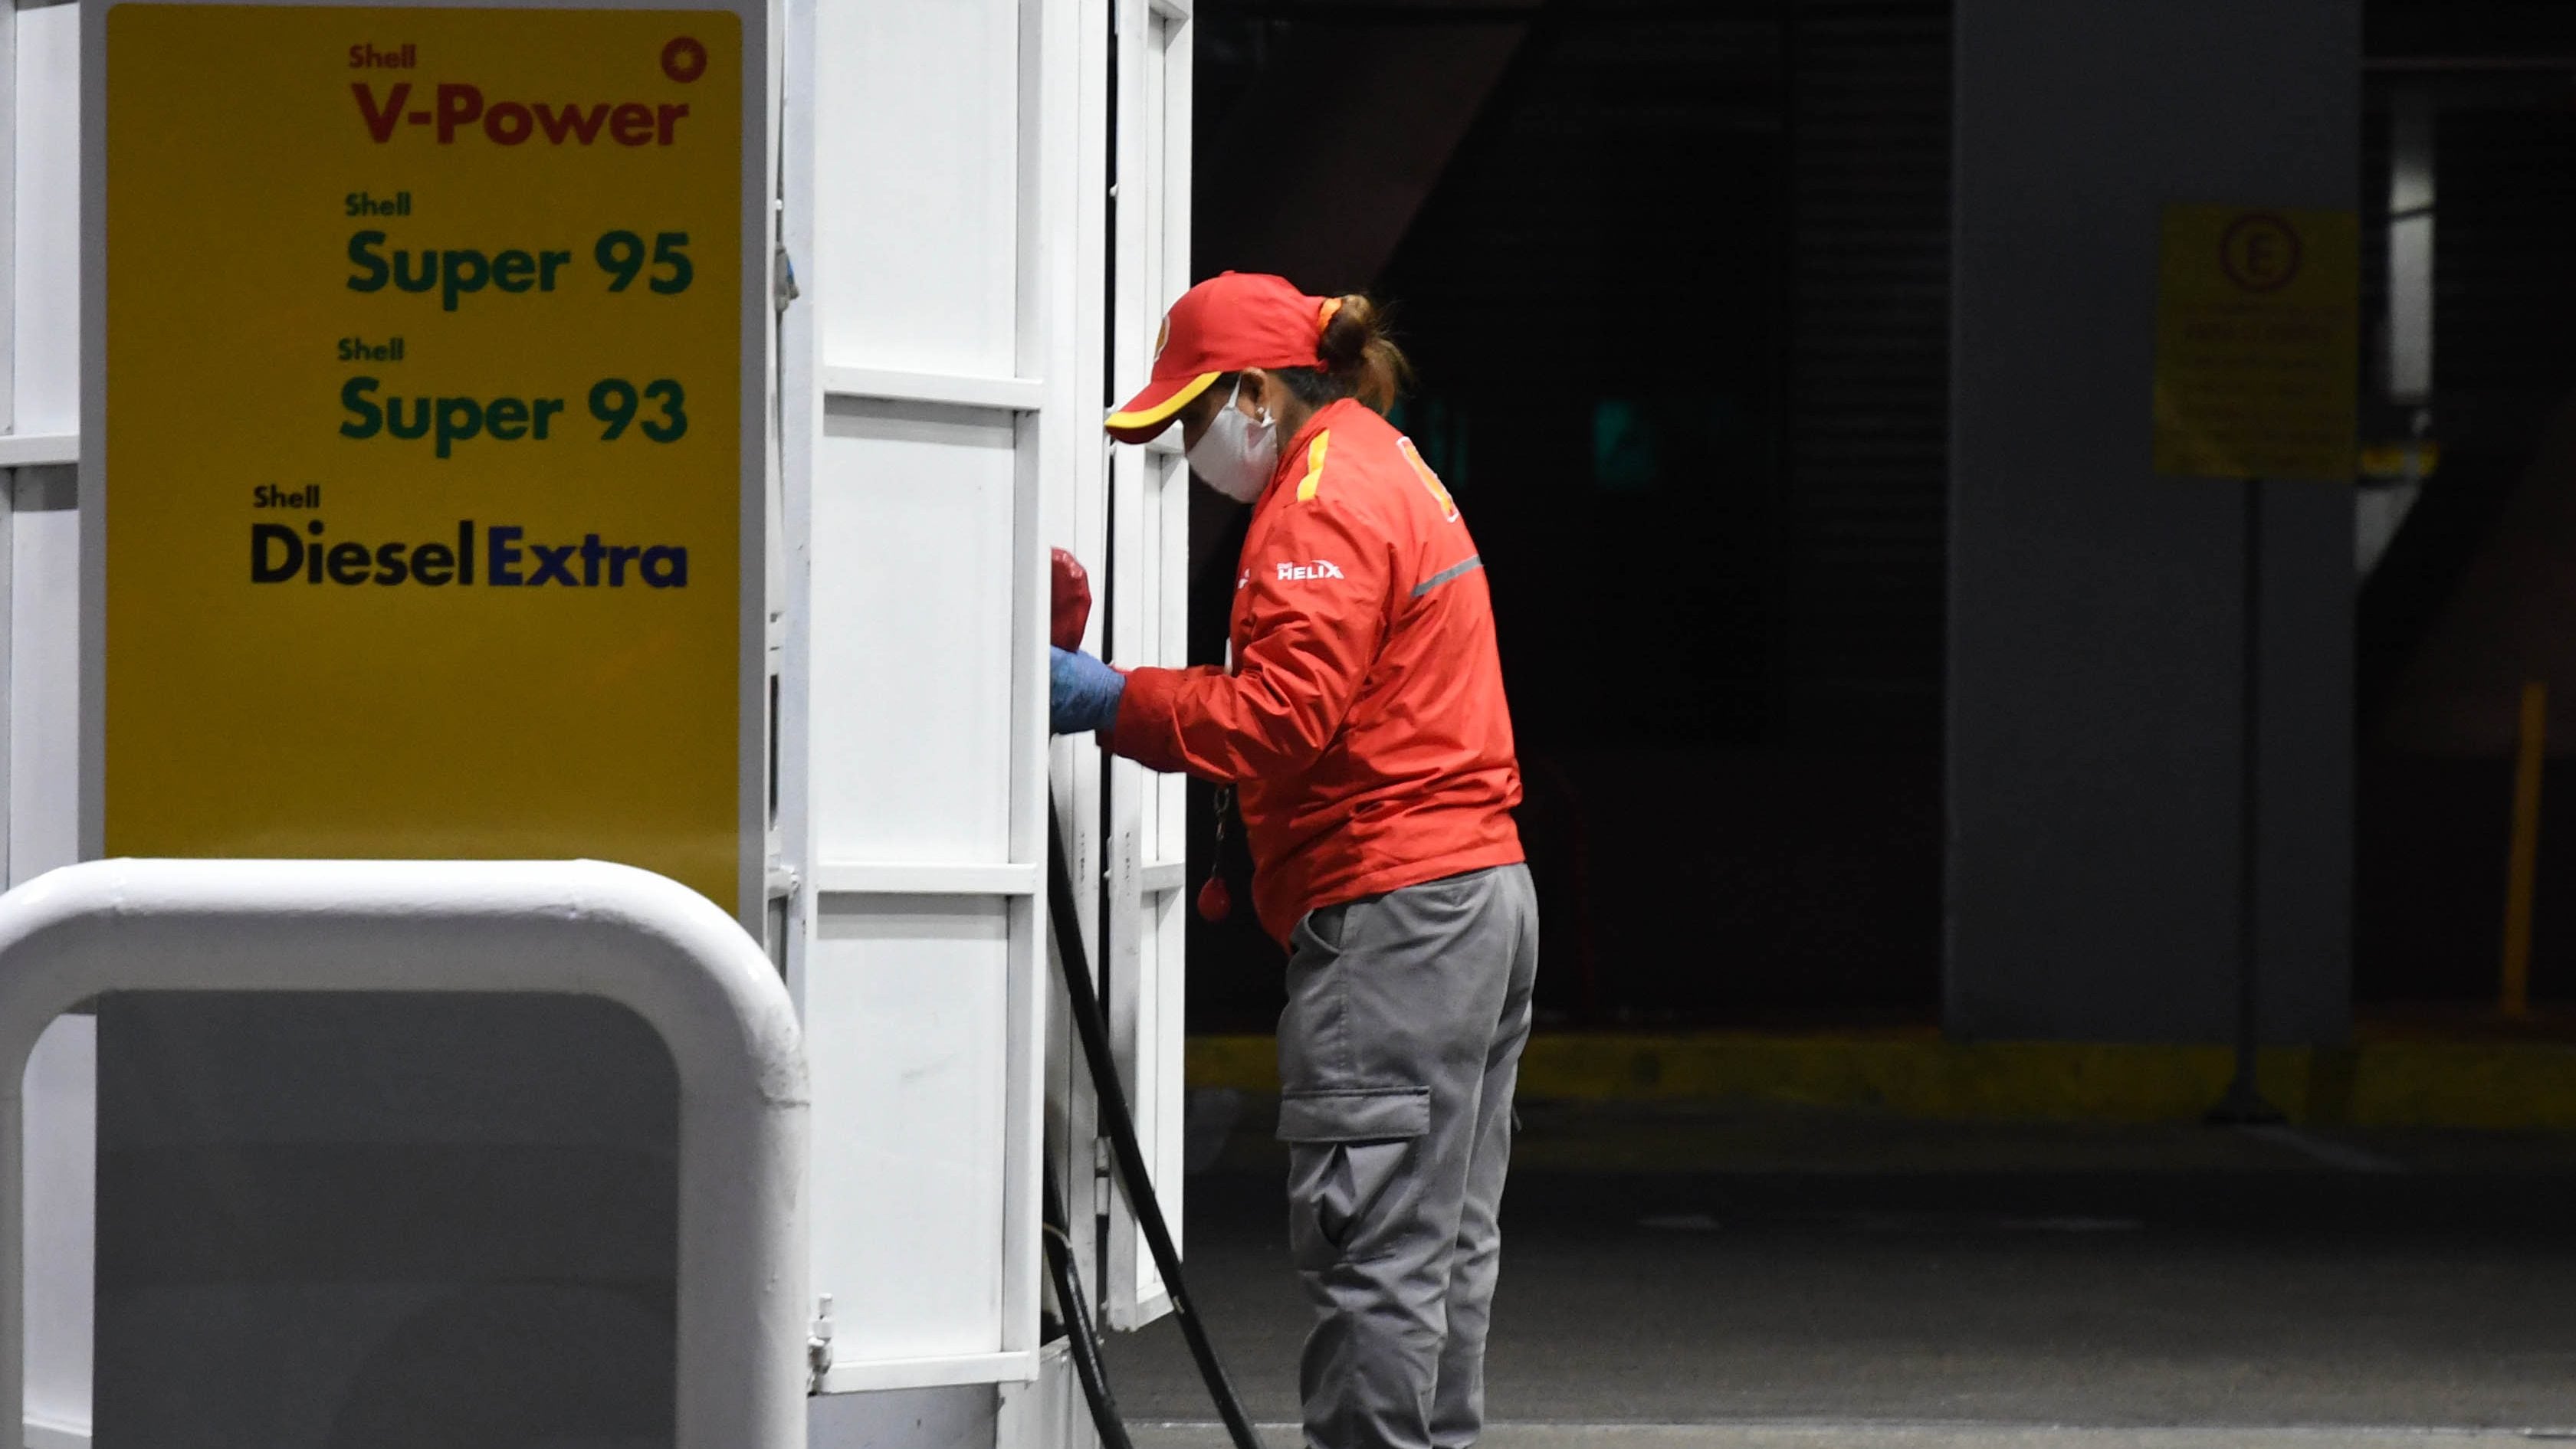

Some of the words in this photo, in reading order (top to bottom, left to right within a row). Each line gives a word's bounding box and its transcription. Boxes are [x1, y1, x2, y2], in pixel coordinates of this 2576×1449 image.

[349, 43, 417, 70] Shell
[351, 82, 689, 146] V-Power
[345, 192, 412, 218] Shell
[2246, 232, 2275, 279] E
[346, 230, 571, 312] Super
[595, 231, 694, 295] 95
[338, 337, 405, 362] Shell
[340, 376, 564, 459] Super
[589, 378, 688, 444] 93
[254, 484, 320, 510] Shell
[1278, 560, 1344, 580] HELIX
